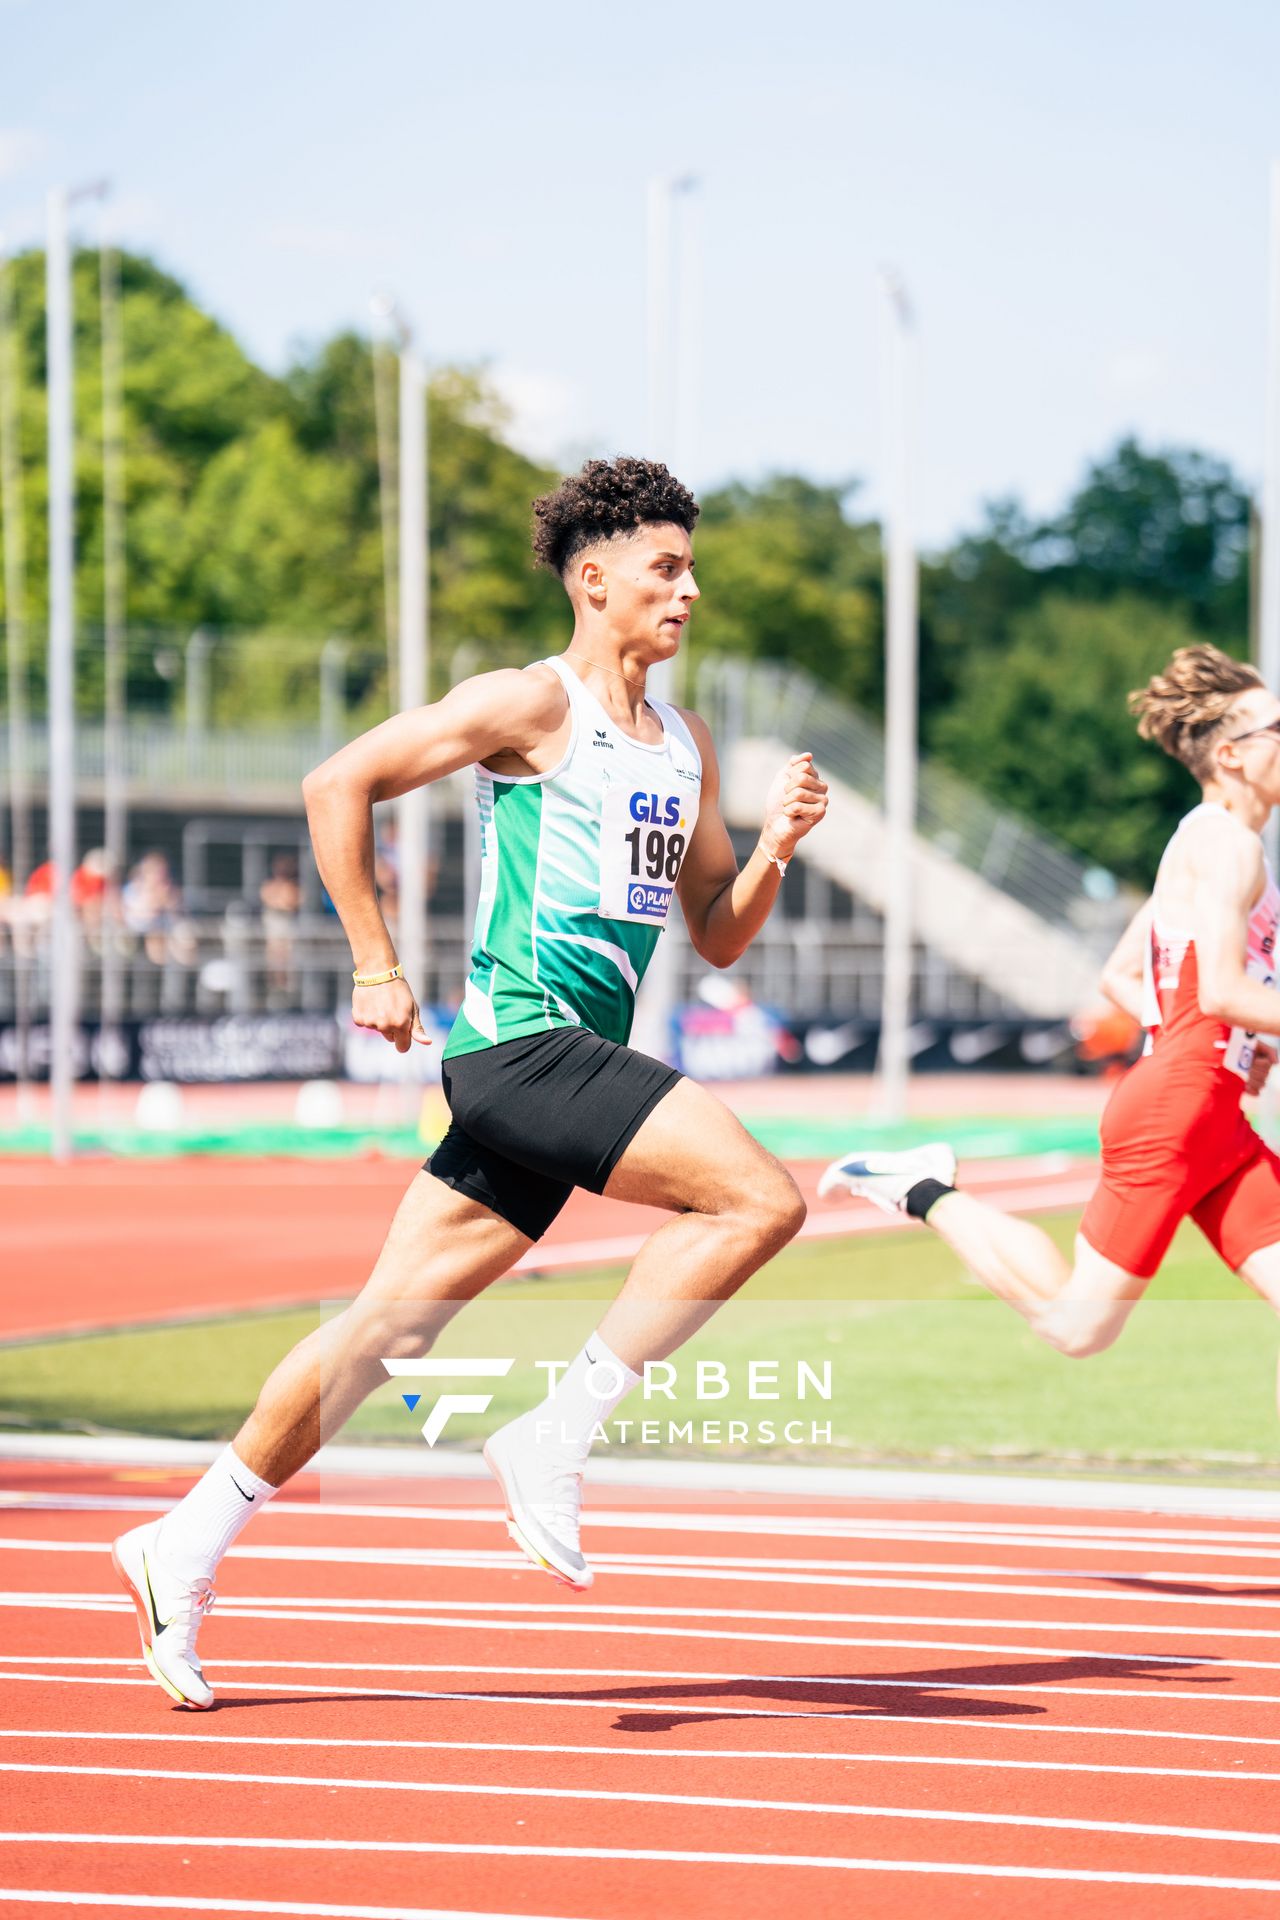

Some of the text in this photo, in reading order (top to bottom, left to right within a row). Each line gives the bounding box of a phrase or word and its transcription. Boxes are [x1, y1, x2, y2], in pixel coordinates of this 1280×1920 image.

[592, 740, 614, 750] erima
[625, 827, 685, 882] 198
[646, 890, 672, 907] PLAN
